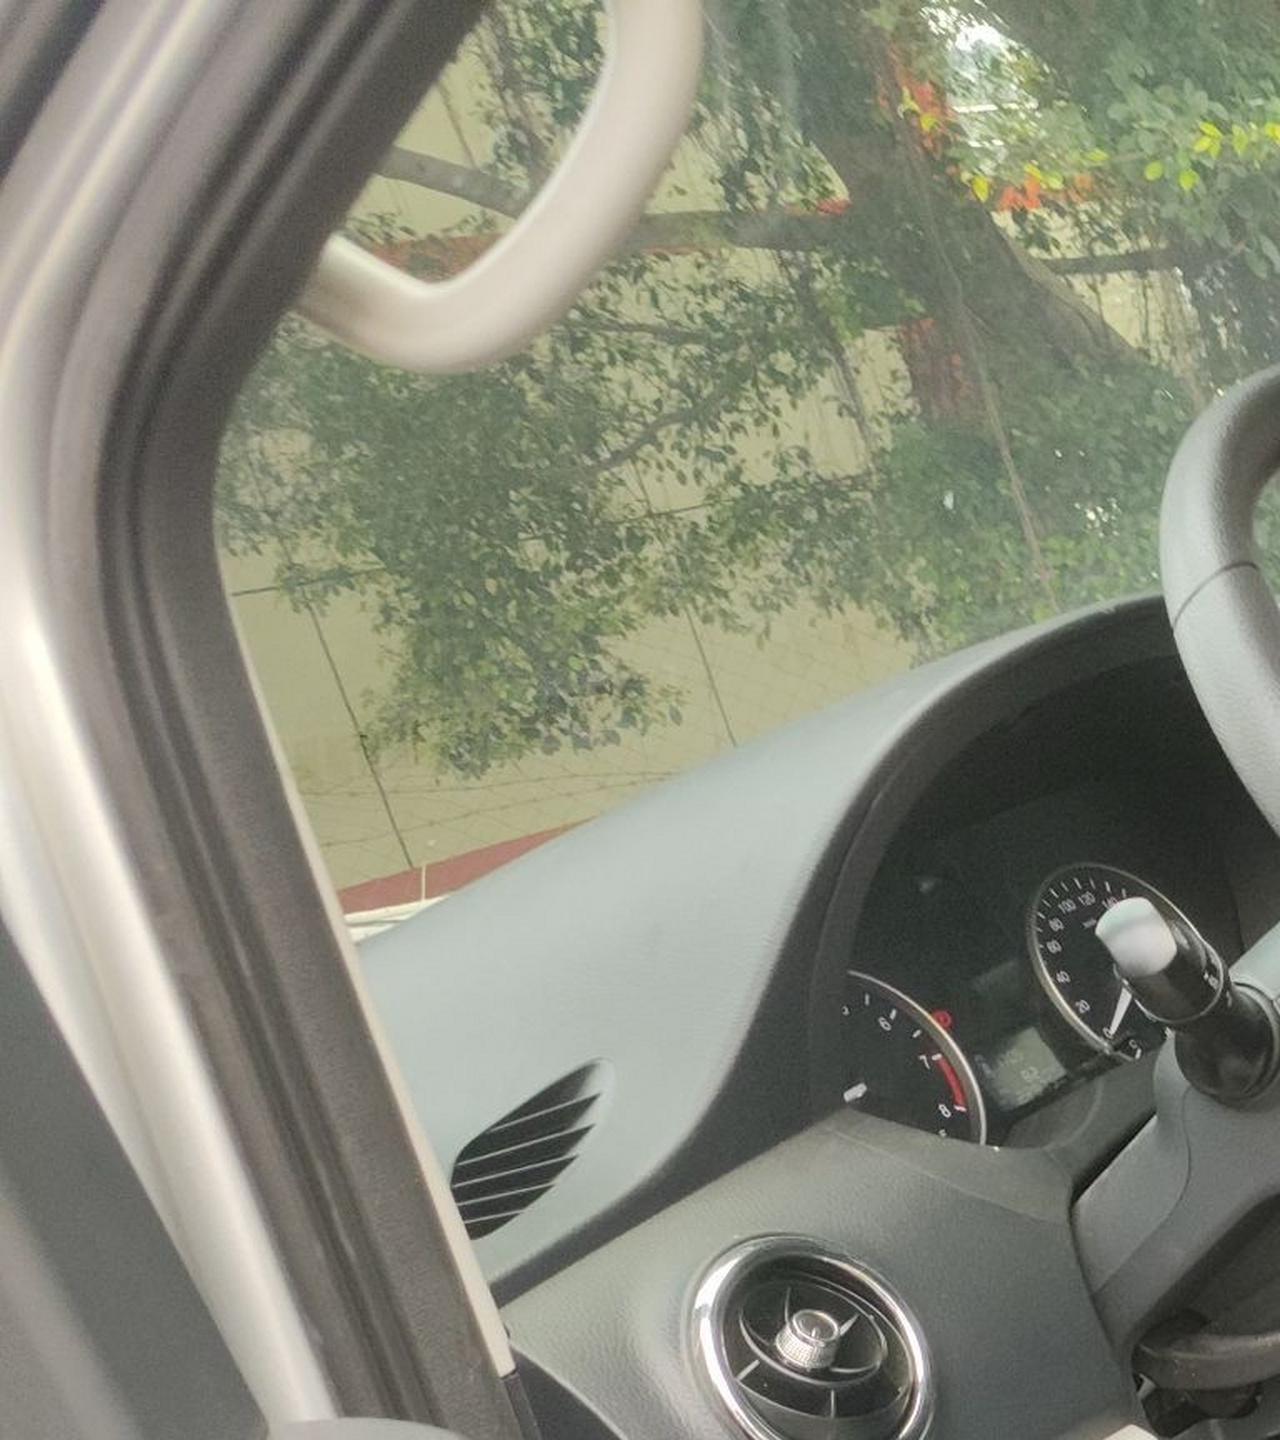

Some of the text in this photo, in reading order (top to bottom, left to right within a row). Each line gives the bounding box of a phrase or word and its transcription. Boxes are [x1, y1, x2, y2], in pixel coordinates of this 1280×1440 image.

[1074, 999, 1091, 1014] 20
[877, 1016, 892, 1032] 6
[918, 1054, 931, 1070] 7
[937, 1103, 952, 1118] 8
